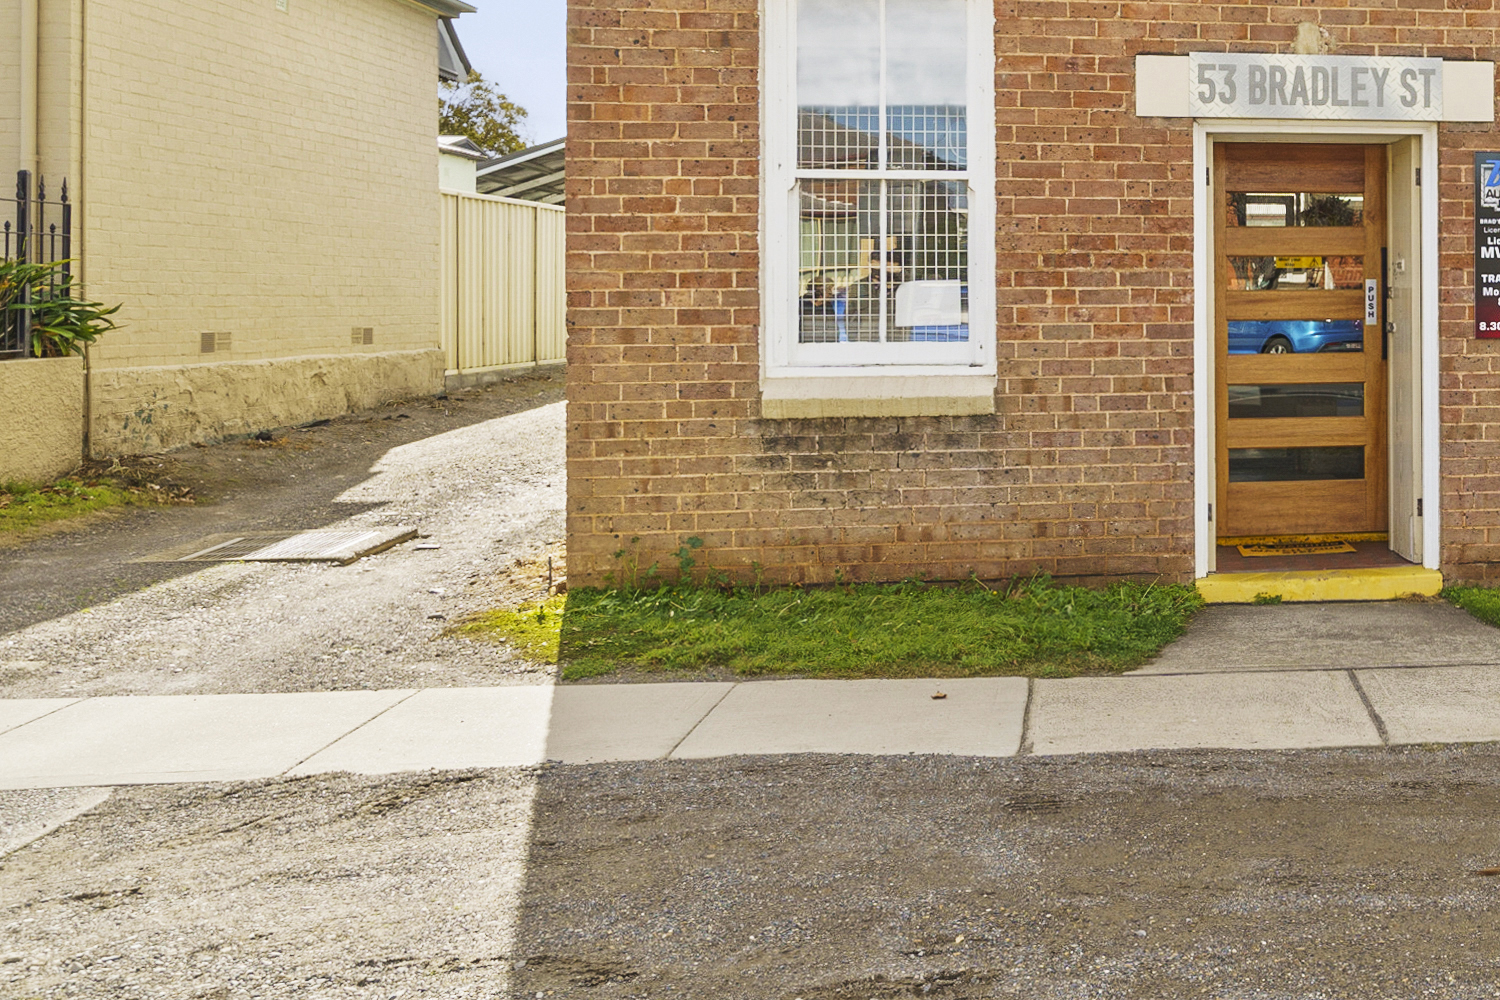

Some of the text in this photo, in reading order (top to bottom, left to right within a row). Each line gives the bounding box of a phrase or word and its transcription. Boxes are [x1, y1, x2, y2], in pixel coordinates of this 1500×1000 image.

[1197, 63, 1436, 109] 53 BRADLEY ST
